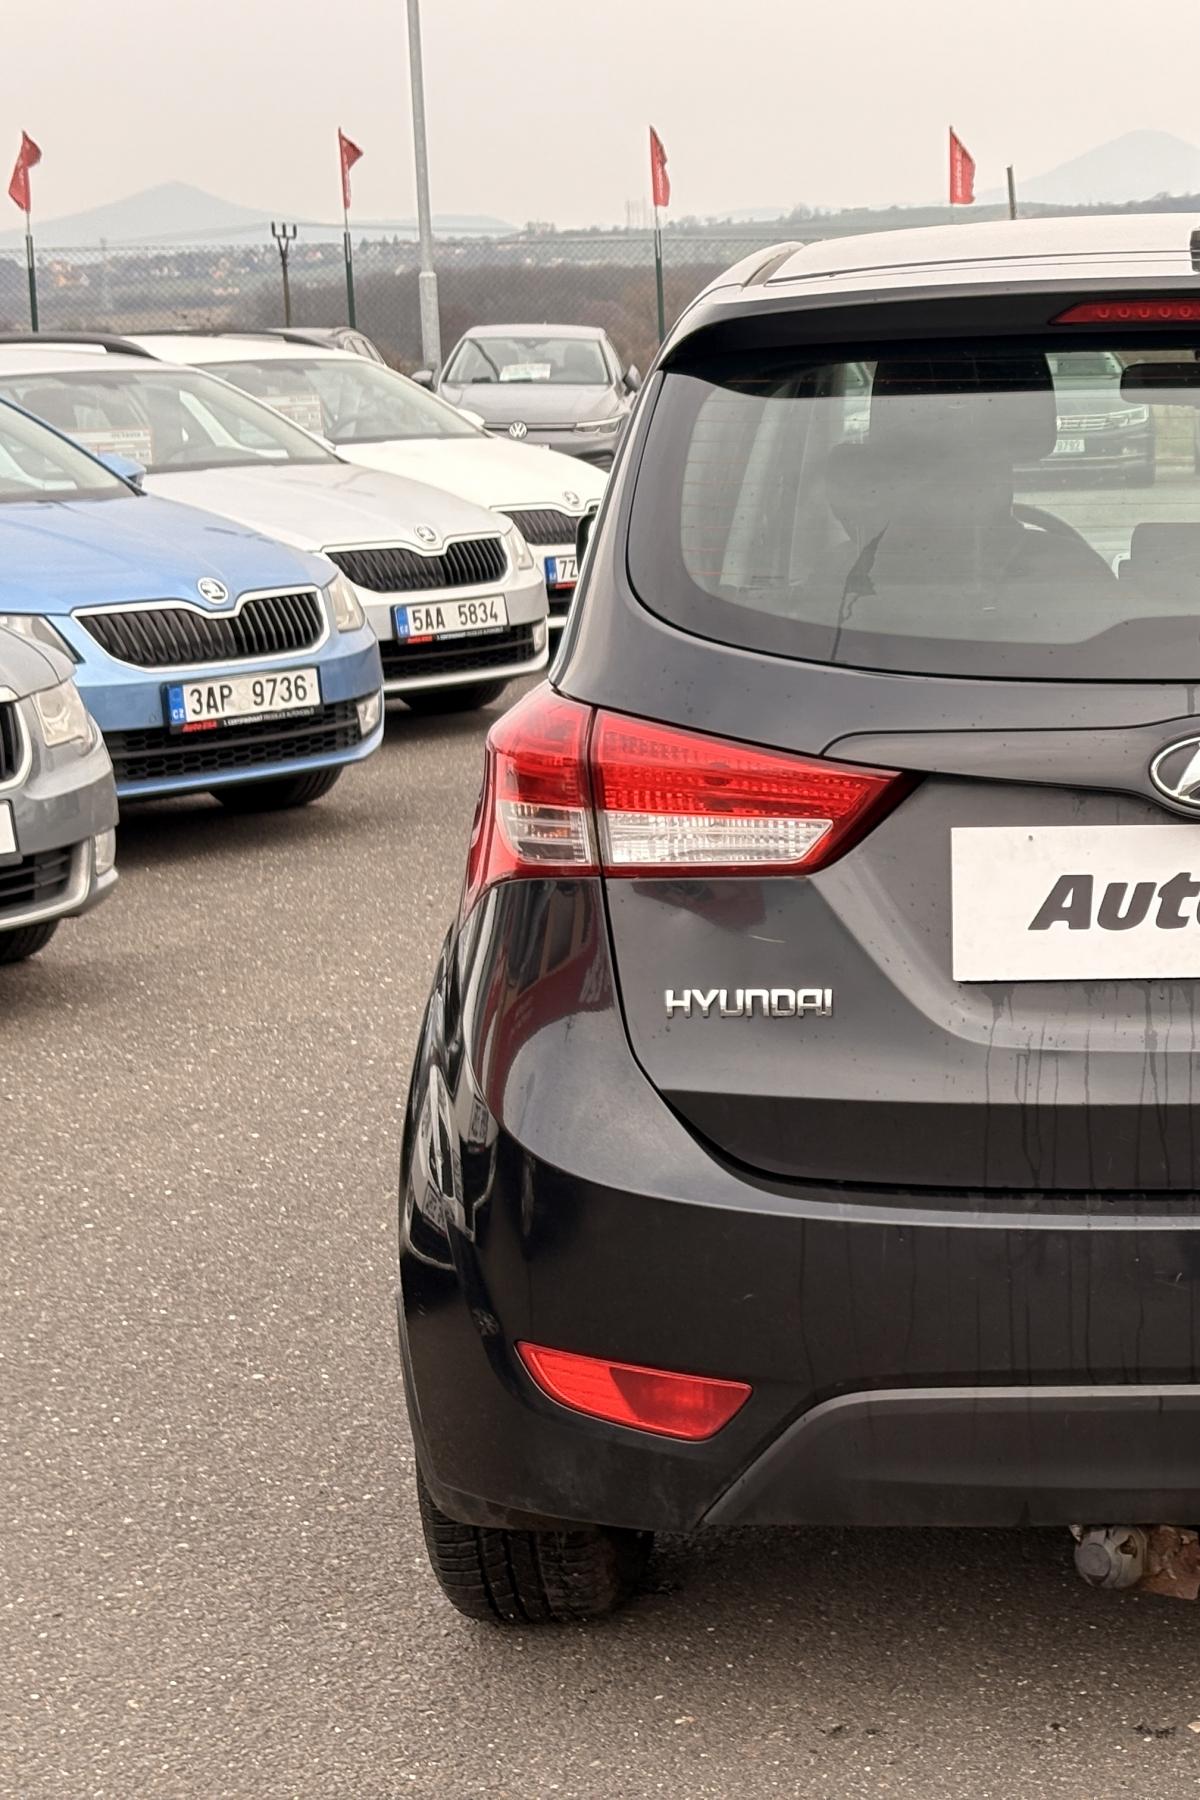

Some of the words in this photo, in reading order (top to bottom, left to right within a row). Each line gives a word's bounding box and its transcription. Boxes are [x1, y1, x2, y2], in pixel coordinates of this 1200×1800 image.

[559, 559, 578, 579] 7Z
[412, 607, 445, 631] 5AA
[457, 601, 498, 626] 5834
[190, 684, 233, 715] 3AP
[252, 675, 308, 706] 9736
[172, 708, 185, 719] CZ
[664, 988, 834, 1018] HYUNDAI
